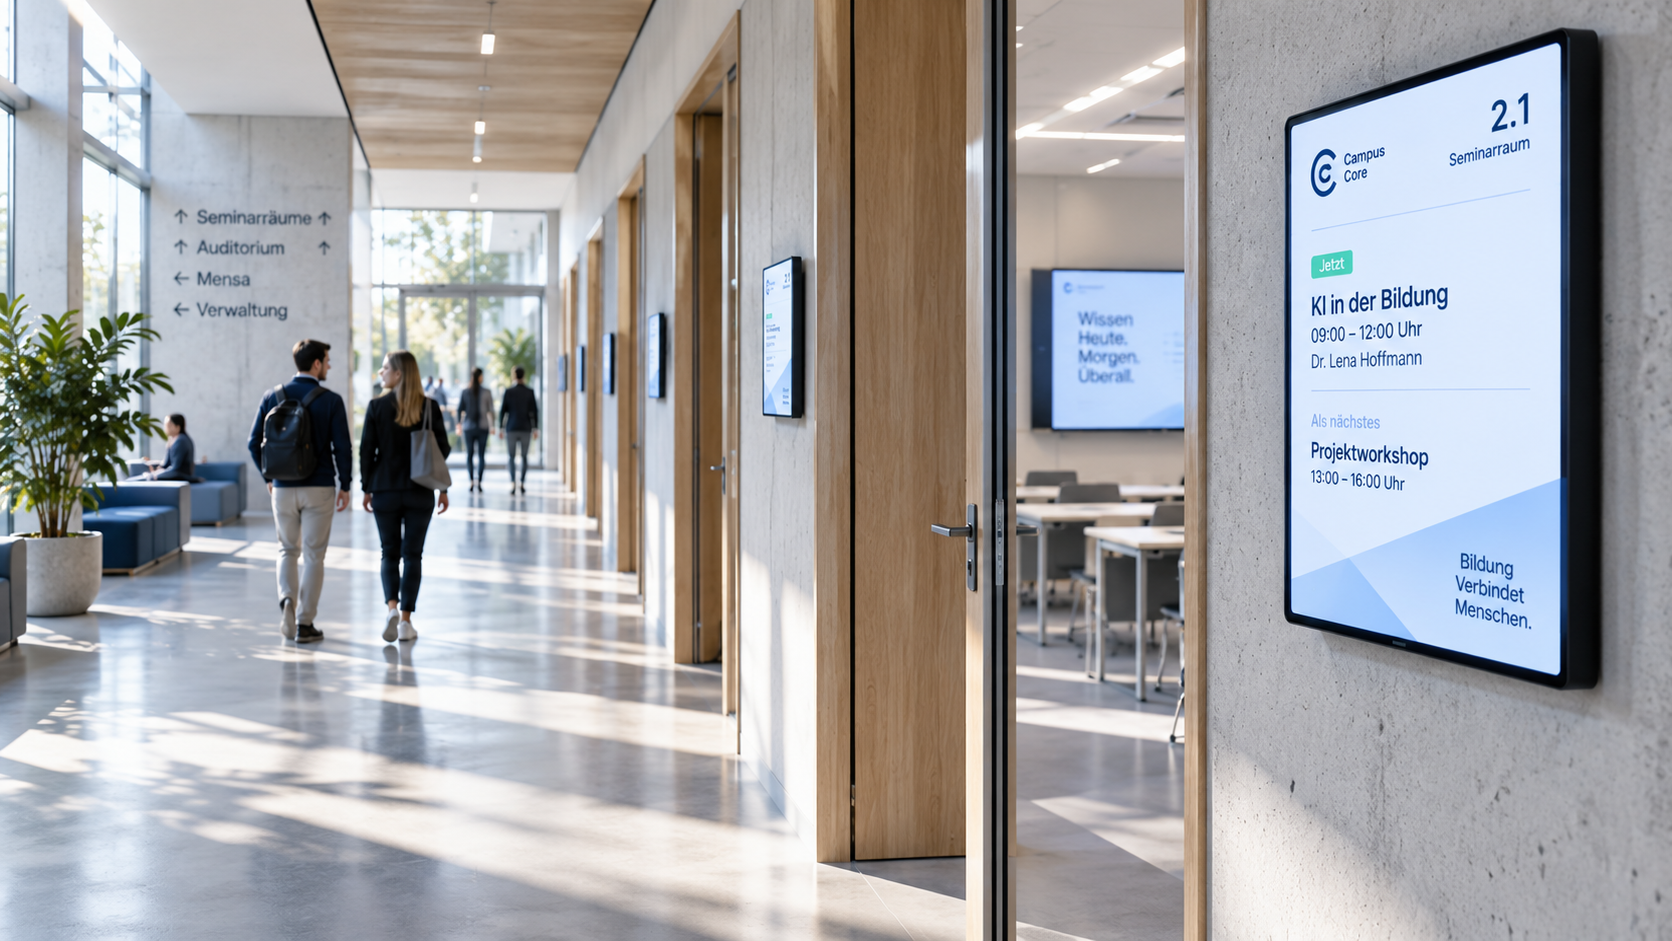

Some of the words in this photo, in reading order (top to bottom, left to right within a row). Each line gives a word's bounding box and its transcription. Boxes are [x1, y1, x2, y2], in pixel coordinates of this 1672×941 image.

[1491, 93, 1530, 133] 2.1
[1344, 146, 1385, 166] Campus
[1449, 137, 1531, 167] Seminarraum
[1344, 168, 1368, 183] Core
[197, 209, 312, 226] Seminarräume
[197, 240, 285, 255] Auditorium
[1319, 257, 1345, 273] Jetzt
[197, 271, 250, 287] Mensa
[1311, 295, 1326, 316] KI
[1331, 294, 1344, 315] in
[1348, 291, 1377, 313] der
[1381, 285, 1449, 310] Bildung
[197, 302, 288, 321] Verwaltung
[1077, 311, 1134, 327] Wissen
[1077, 330, 1128, 345] Heute.
[1311, 326, 1346, 344] 09:00
[1359, 322, 1394, 341] 12:00
[1398, 320, 1423, 338] Uhr
[1077, 350, 1140, 367] Morgen.
[1311, 353, 1327, 369] Dr.
[1329, 353, 1357, 368] Lena
[1360, 350, 1422, 368] Hoffmann
[1077, 365, 1134, 384] Überall.
[1311, 413, 1328, 428] Als
[1330, 414, 1381, 430] nächstes
[1311, 441, 1429, 471] Projektworkshop
[1311, 469, 1339, 486] 13:00
[1350, 472, 1381, 489] 16:00
[1384, 475, 1405, 491] Uhr
[1460, 552, 1514, 580] Bildung
[1455, 574, 1525, 604] Verbindet
[1455, 598, 1533, 630] Menschen.
